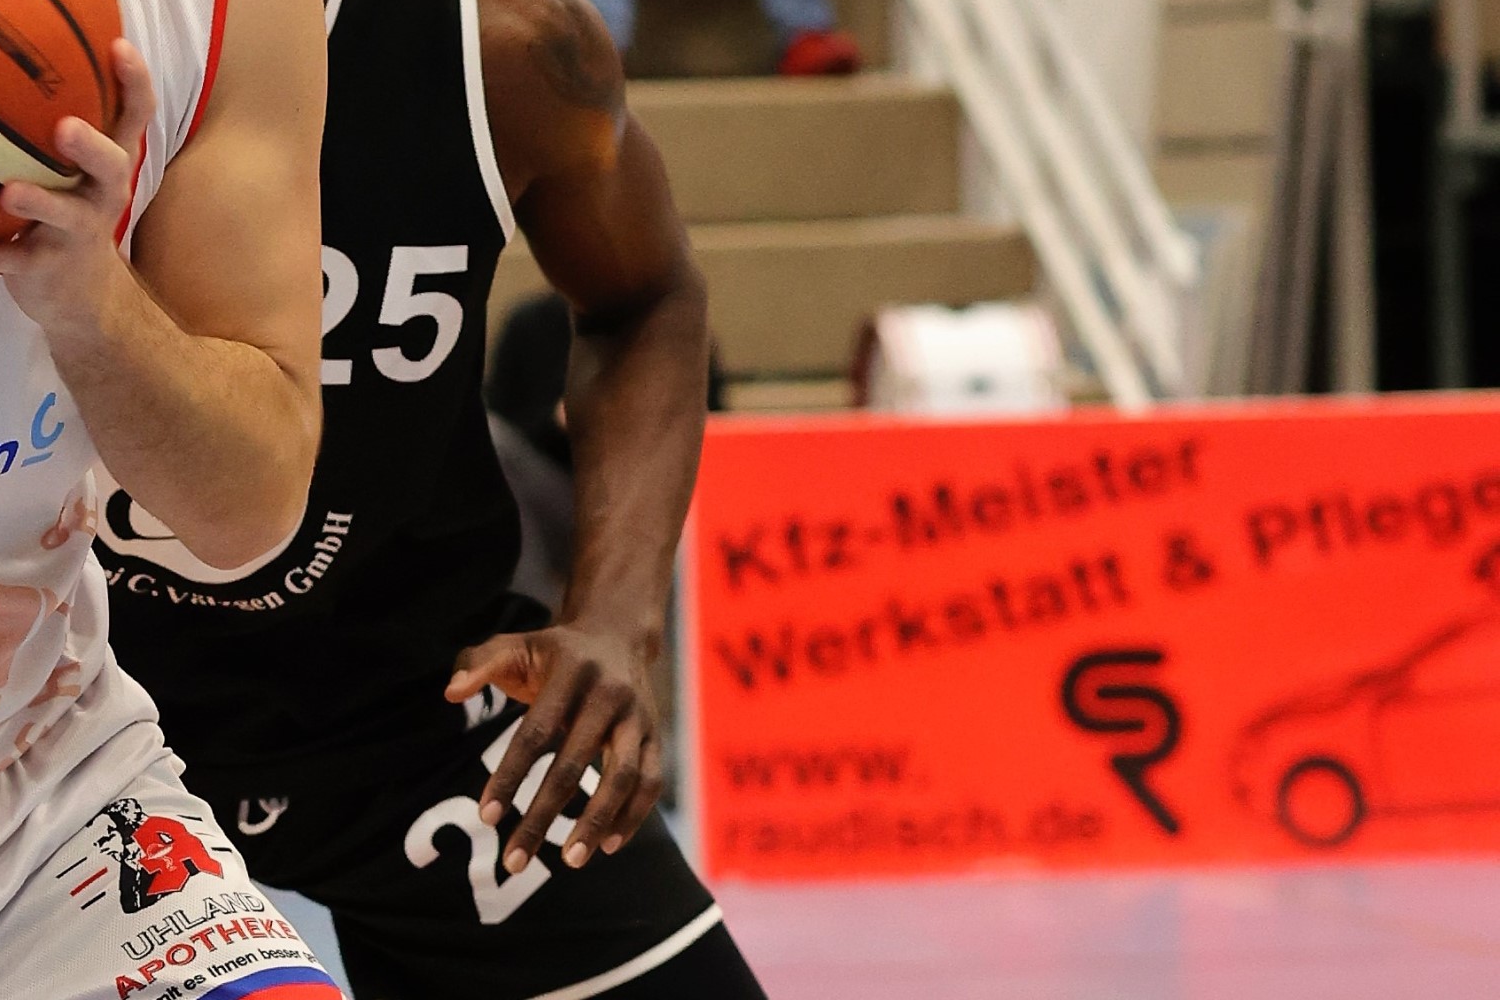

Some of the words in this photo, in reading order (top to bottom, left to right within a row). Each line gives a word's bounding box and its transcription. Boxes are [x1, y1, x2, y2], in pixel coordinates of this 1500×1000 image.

[284, 510, 354, 595] GmbH
[717, 436, 1205, 592] Kfz-Meister
[713, 553, 1132, 692] Werkstatt
[1161, 527, 1217, 591] &
[115, 916, 299, 1000] APOTHEKE
[121, 891, 265, 961] UHLAND
[184, 974, 206, 991] es
[207, 952, 258, 978] Ihnen
[257, 948, 302, 960] besser
